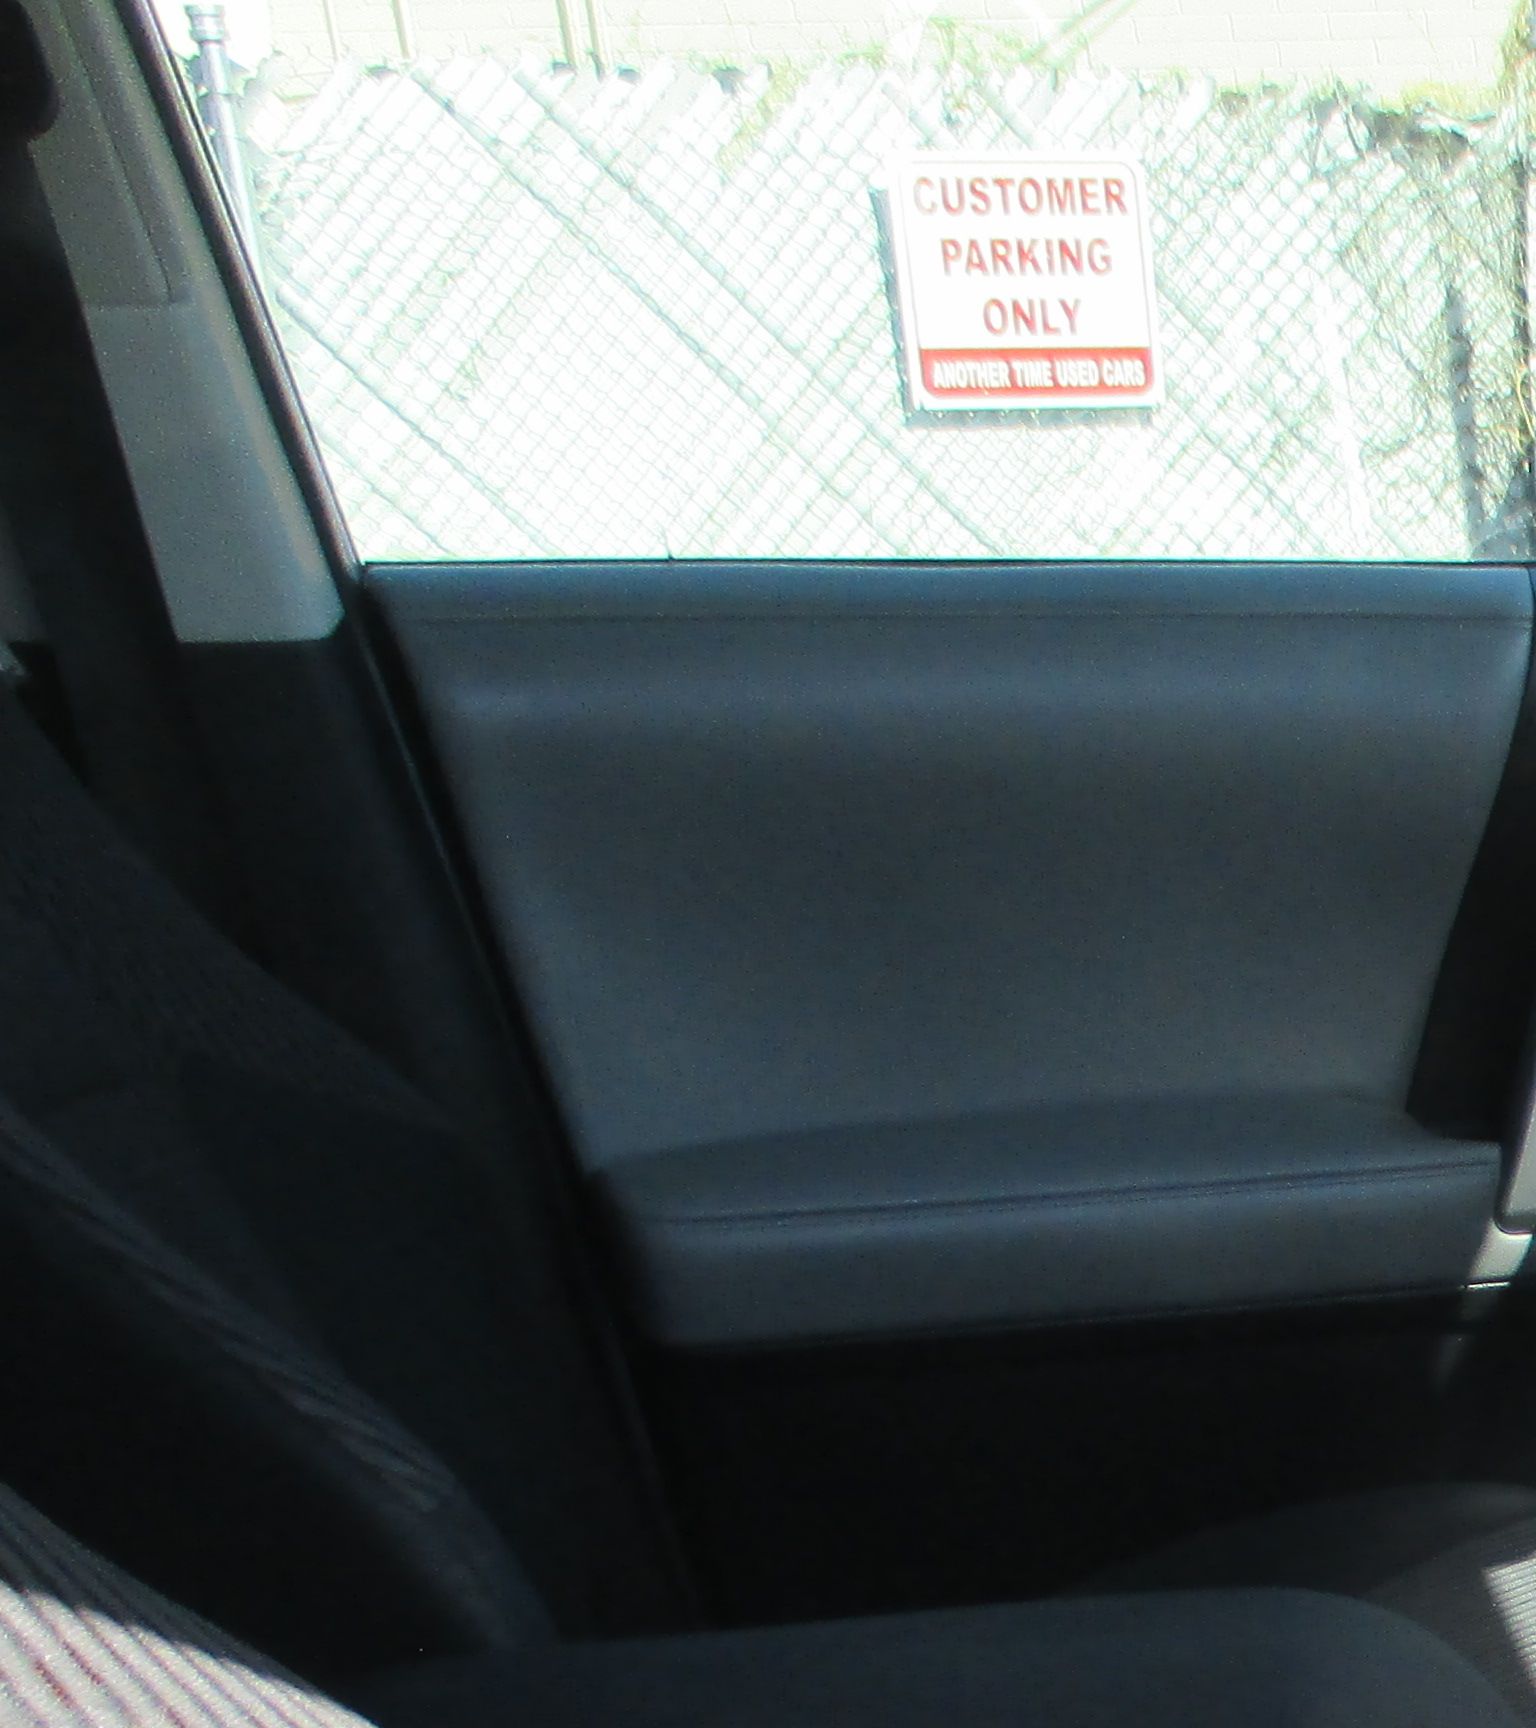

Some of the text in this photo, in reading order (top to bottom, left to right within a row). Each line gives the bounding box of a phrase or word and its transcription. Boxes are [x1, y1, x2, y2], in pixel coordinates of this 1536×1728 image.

[912, 176, 1129, 216] CUSTOMER
[939, 237, 1113, 277] PARKING
[982, 297, 1082, 336] ONLY
[932, 358, 1147, 390] ANOTHER TIME USED CARS
